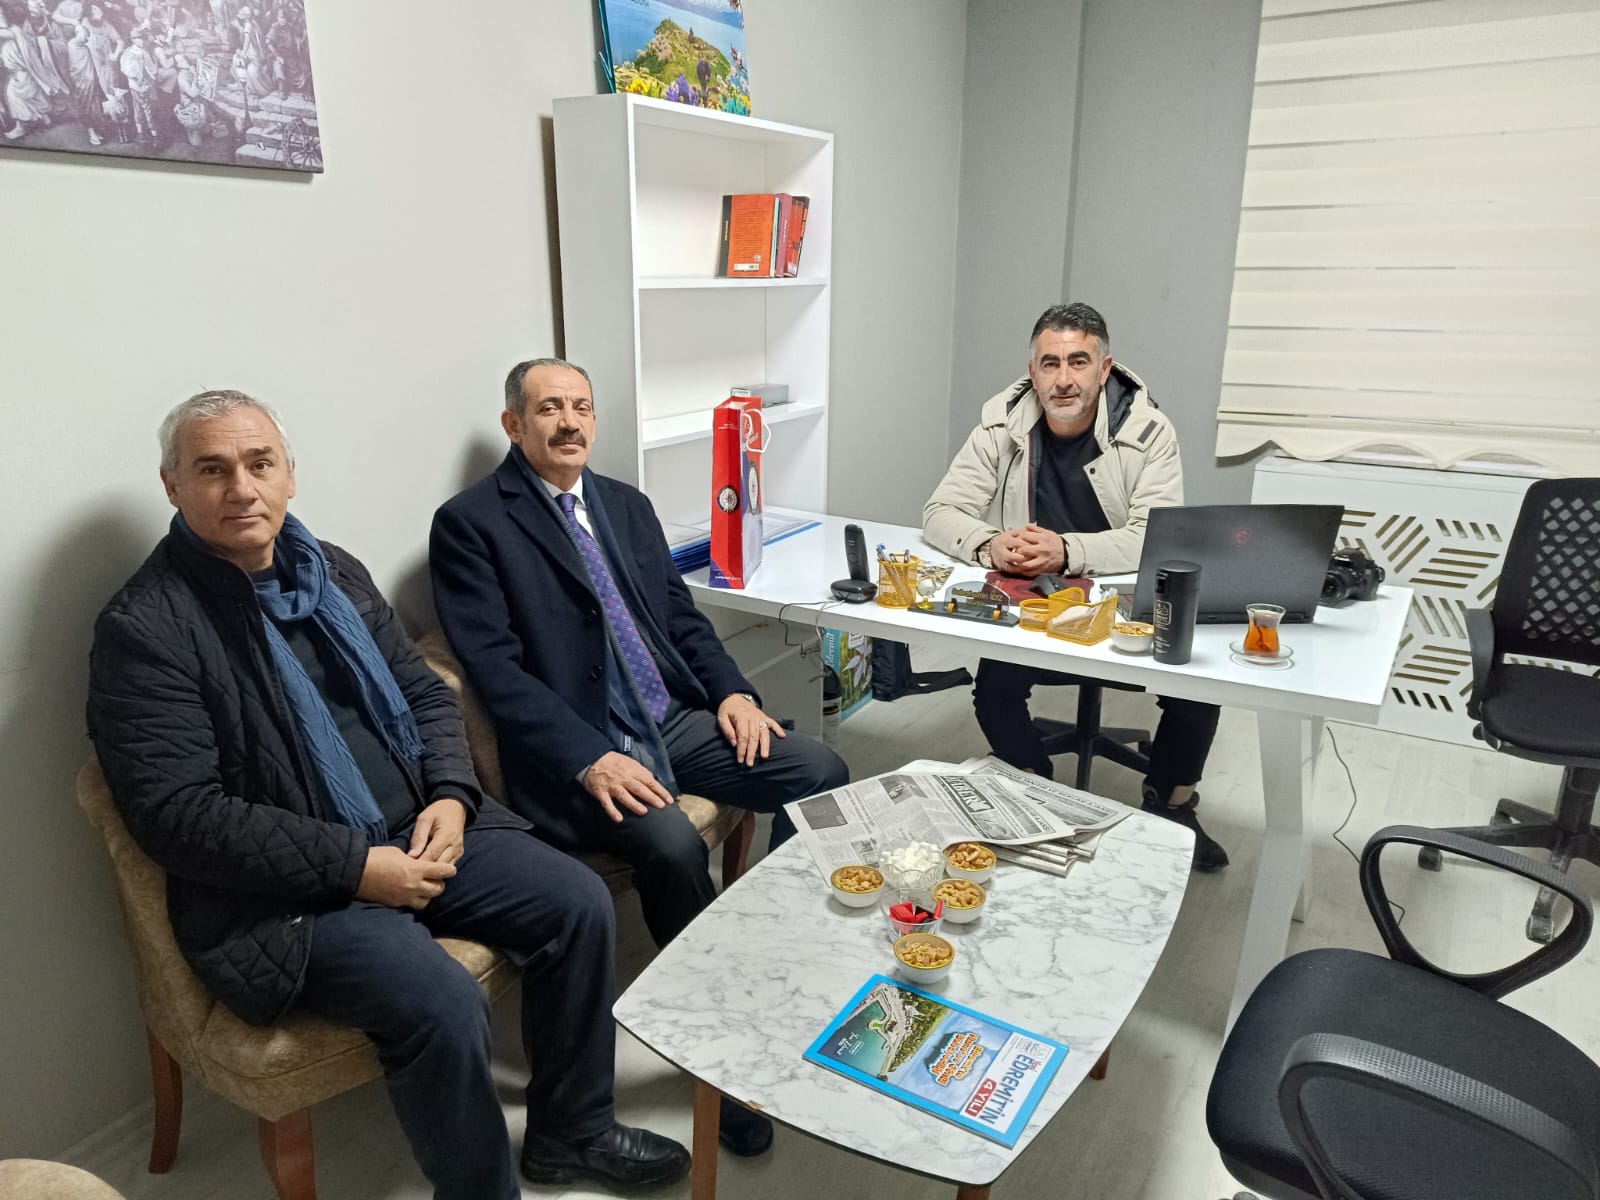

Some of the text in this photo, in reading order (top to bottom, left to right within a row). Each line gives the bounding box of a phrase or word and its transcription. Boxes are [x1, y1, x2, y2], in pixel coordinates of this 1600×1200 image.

[966, 1079, 995, 1114] 4 YILI
[980, 1055, 1030, 1124] EDREMİT'İN
